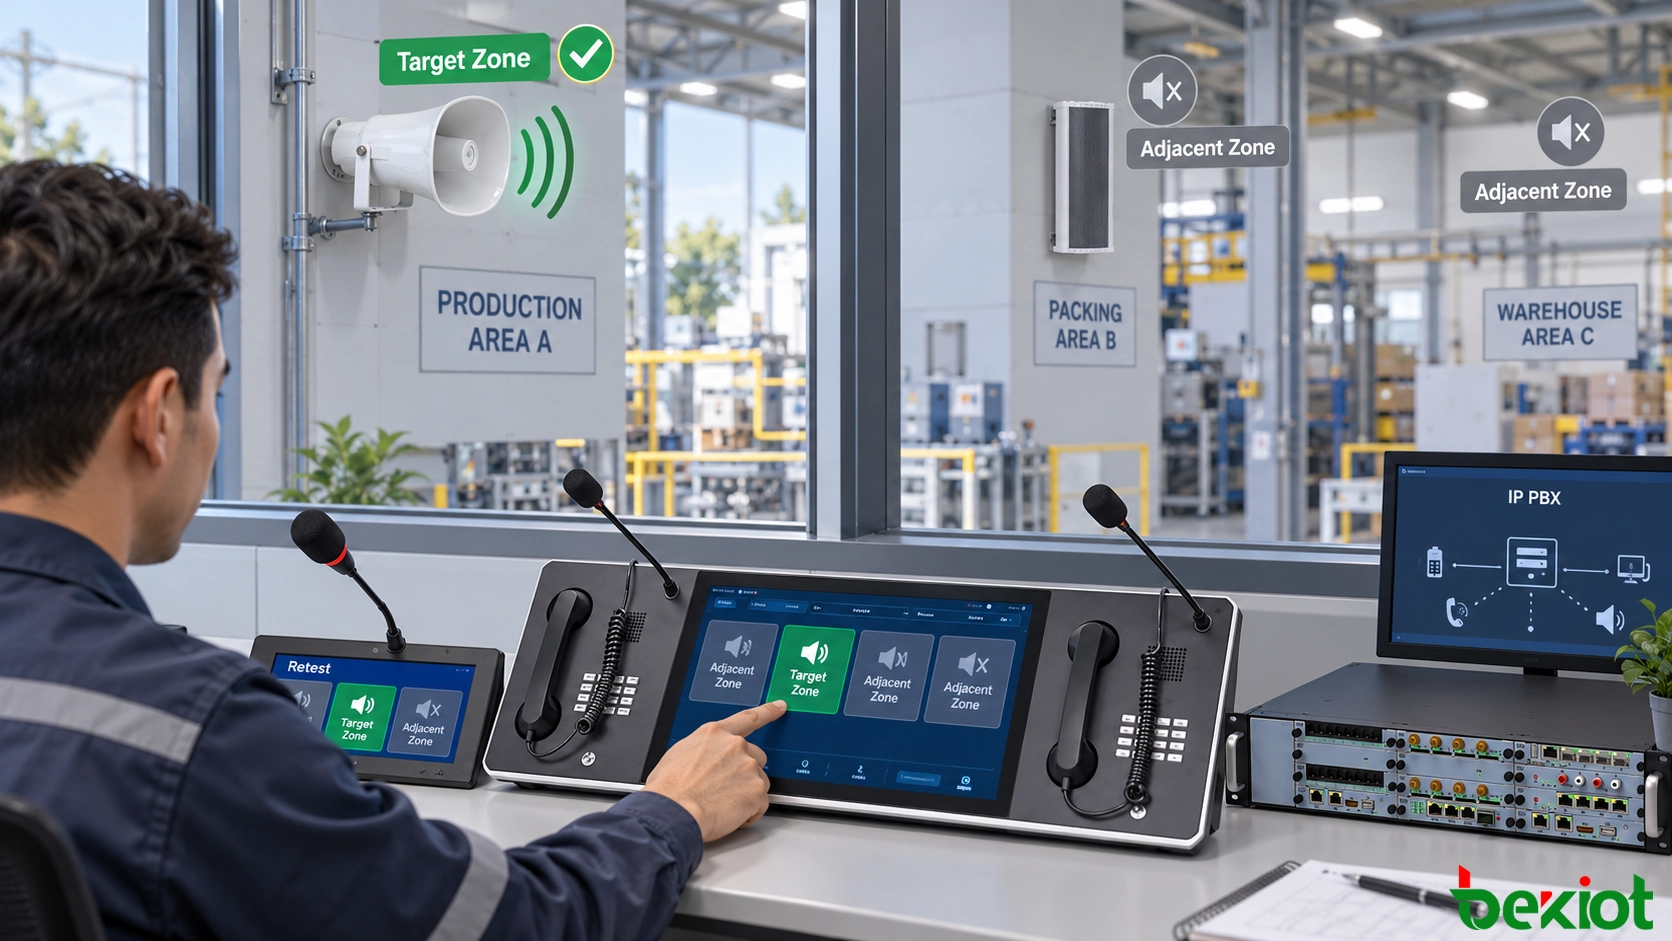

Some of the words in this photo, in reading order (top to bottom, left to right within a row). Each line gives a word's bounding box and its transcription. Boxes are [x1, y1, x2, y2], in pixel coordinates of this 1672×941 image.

[438, 289, 582, 321] PRODUCTION
[1049, 300, 1122, 323] PACKING
[1497, 300, 1622, 321] WAREHOUSE
[468, 327, 531, 353] AREA
[536, 329, 553, 354] A
[1055, 328, 1101, 350] AREA
[1106, 330, 1117, 350] B
[1521, 327, 1575, 346] AREA
[1580, 326, 1594, 346] C
[1508, 489, 1524, 504] IP
[1528, 490, 1562, 505] PBX
[287, 660, 331, 675] Retest
[709, 662, 755, 679] Adjacent
[714, 676, 743, 690] Zone
[790, 668, 827, 685] Target
[863, 674, 912, 692] Adjacent
[790, 684, 820, 698] Zone
[869, 690, 899, 704] Zone
[943, 681, 993, 698] Adjacent
[950, 697, 980, 711] Zone
[341, 717, 374, 731] Target
[402, 722, 445, 736] Adjacent
[341, 730, 368, 742] Zone
[407, 735, 434, 747] Zone
